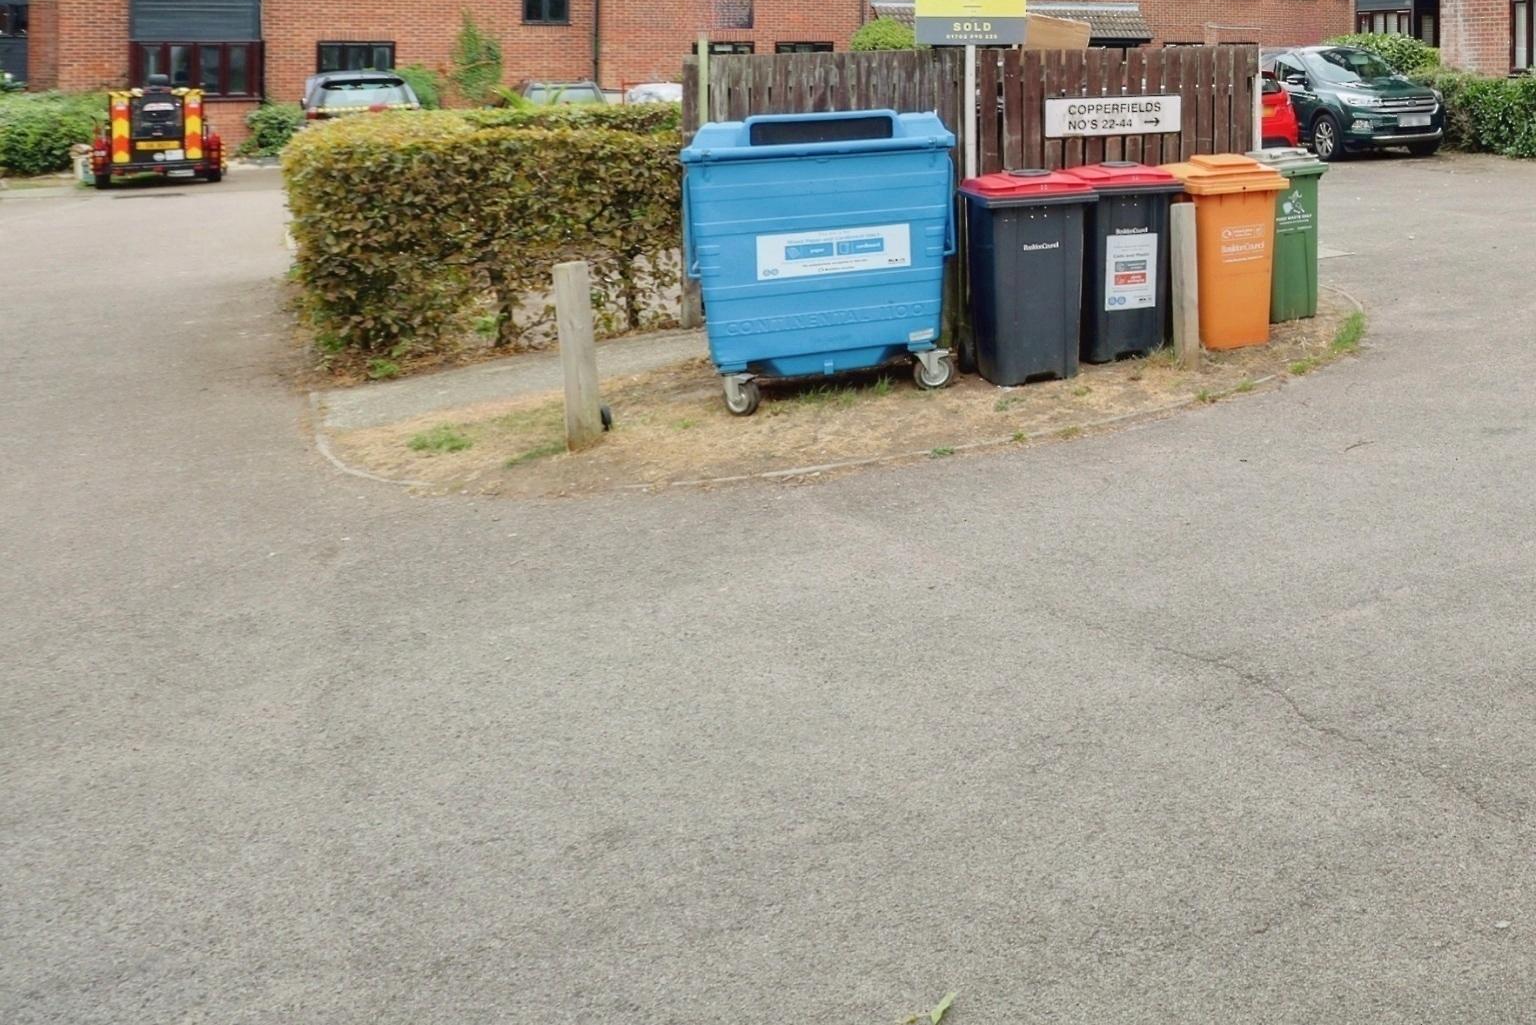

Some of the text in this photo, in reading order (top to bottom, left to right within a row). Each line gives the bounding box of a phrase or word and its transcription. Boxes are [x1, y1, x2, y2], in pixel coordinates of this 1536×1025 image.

[953, 22, 991, 32] SOLD
[1068, 102, 1161, 115] COPPERFIELDS
[1068, 119, 1132, 130] NO'S 22-44
